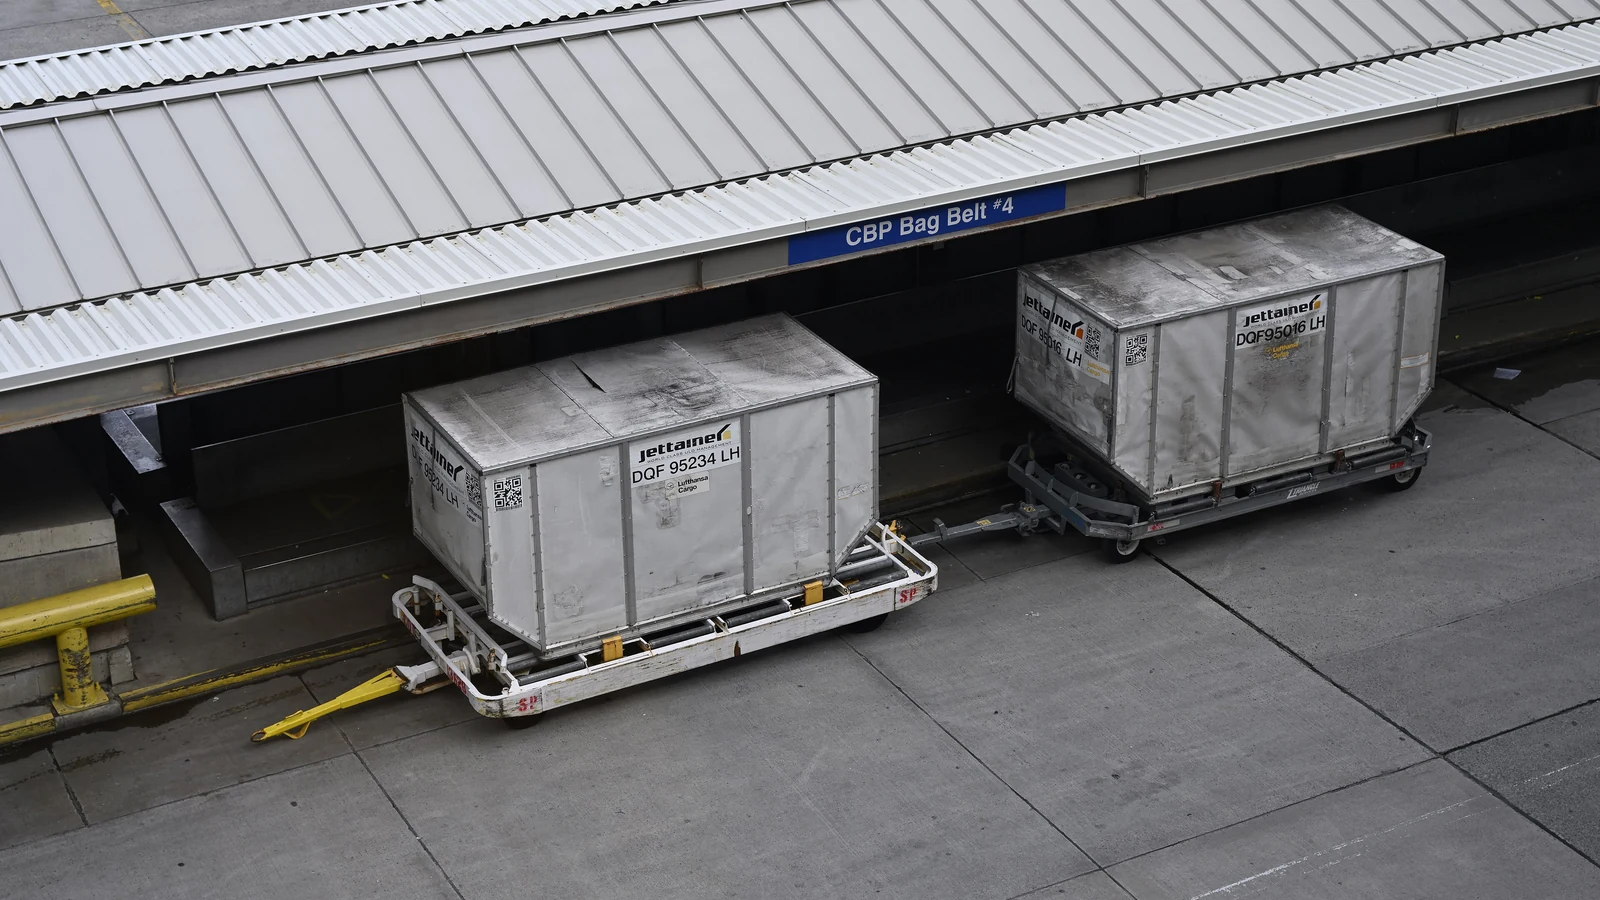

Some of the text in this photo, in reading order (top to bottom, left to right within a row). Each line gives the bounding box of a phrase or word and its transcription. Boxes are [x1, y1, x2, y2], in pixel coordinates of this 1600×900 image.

[846, 196, 1014, 247] CBP Bag Belt #4
[1310, 315, 1326, 331] LH
[1021, 314, 1038, 335] DQF
[1038, 327, 1062, 355] 95016
[1066, 347, 1083, 367] LH
[632, 446, 740, 484] DQF 95234 LH
[677, 475, 709, 487] Lufthansa
[677, 484, 698, 494] Cargo
[446, 487, 459, 509] LH
